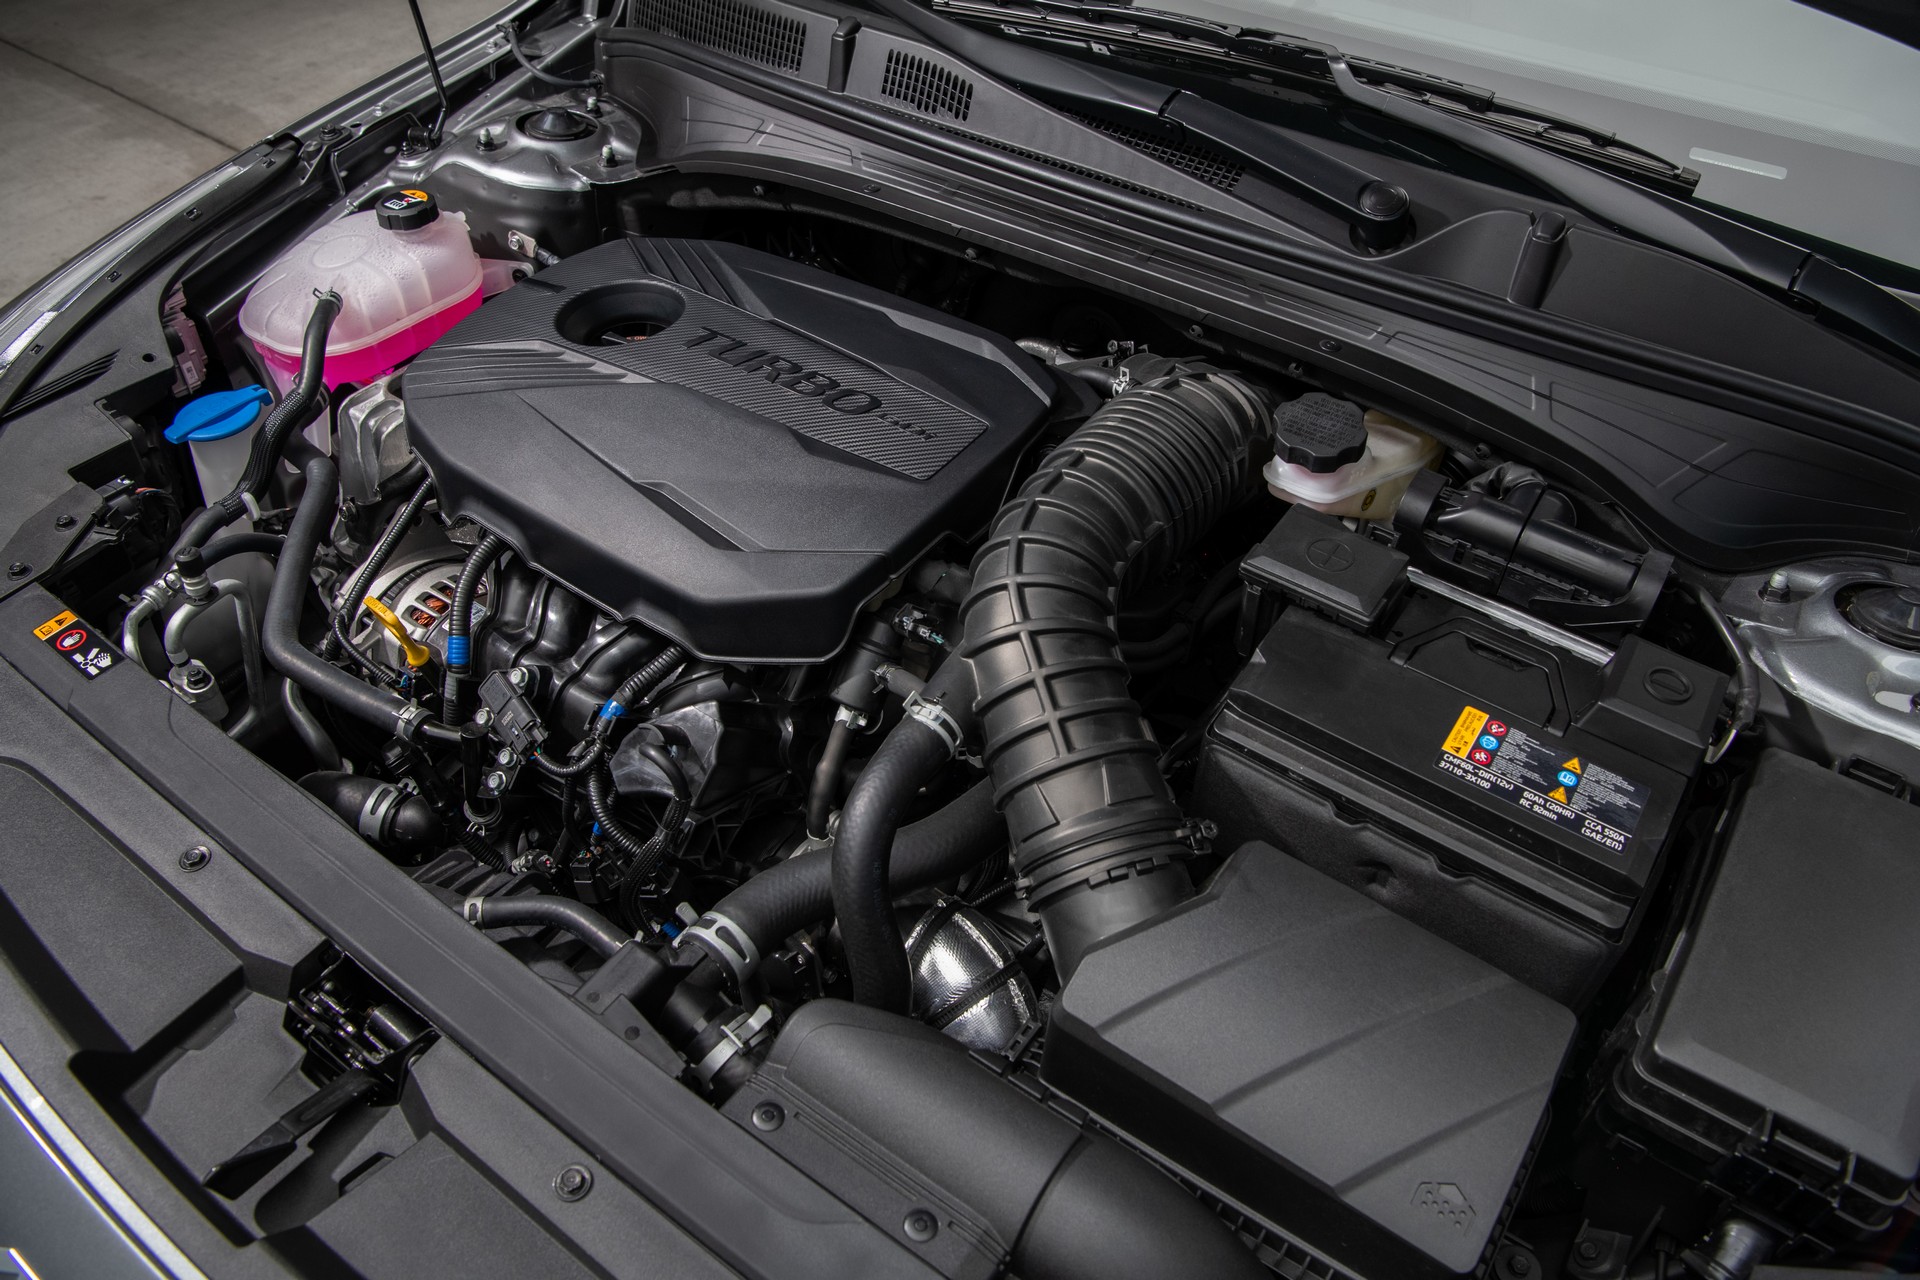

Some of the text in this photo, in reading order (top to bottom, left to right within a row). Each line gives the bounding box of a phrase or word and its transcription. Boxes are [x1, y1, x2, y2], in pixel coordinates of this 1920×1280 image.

[682, 326, 883, 415] TURBO
[1438, 760, 1491, 789] 37110-3X100
[1519, 798, 1558, 821] RC 92min
[1523, 791, 1545, 805] 60Ah
[1546, 801, 1575, 819] (20HR)
[1584, 820, 1625, 843] CCA 550A
